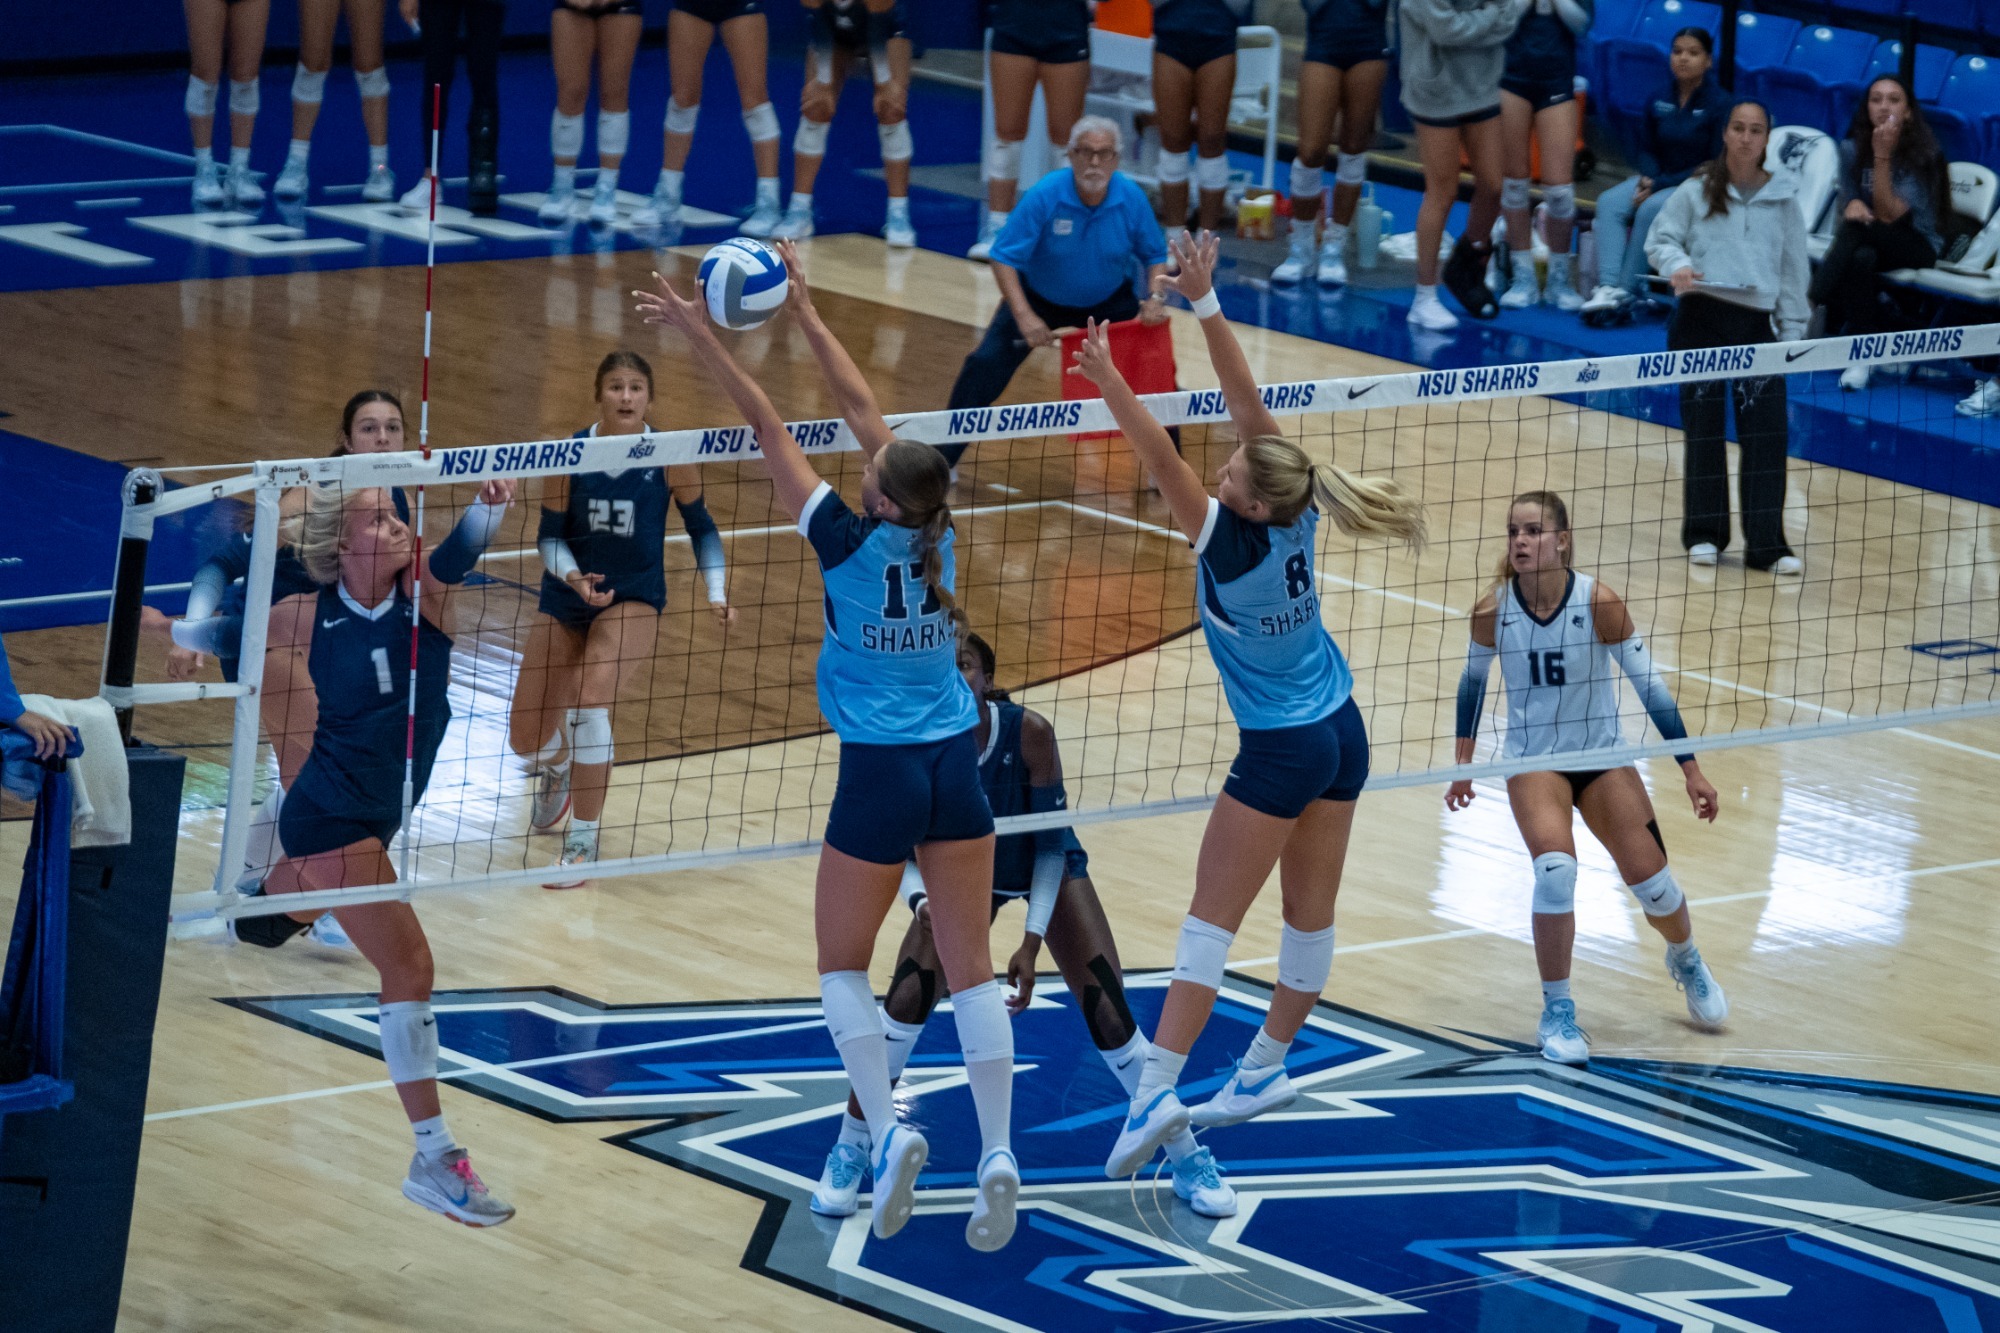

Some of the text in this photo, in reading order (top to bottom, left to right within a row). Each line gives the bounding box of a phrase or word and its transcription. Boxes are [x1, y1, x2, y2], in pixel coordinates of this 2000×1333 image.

[1637, 346, 1756, 378] NSU SHARKS
[1849, 329, 1964, 360] NSU SHARKS
[1257, 383, 1316, 410] ARKS
[1417, 365, 1540, 397] NSU SHARKS
[948, 402, 1082, 435] NSU SHARKS
[439, 441, 585, 476] NSU SHARKS
[626, 445, 656, 459] NSU
[697, 428, 746, 454] NSU
[588, 498, 635, 537] 23
[1283, 546, 1311, 600] 8
[881, 562, 941, 620] 17
[1260, 595, 1318, 636] SHAR
[861, 616, 952, 653] SHARK
[371, 647, 393, 695] 1
[1527, 651, 1566, 687] 16
